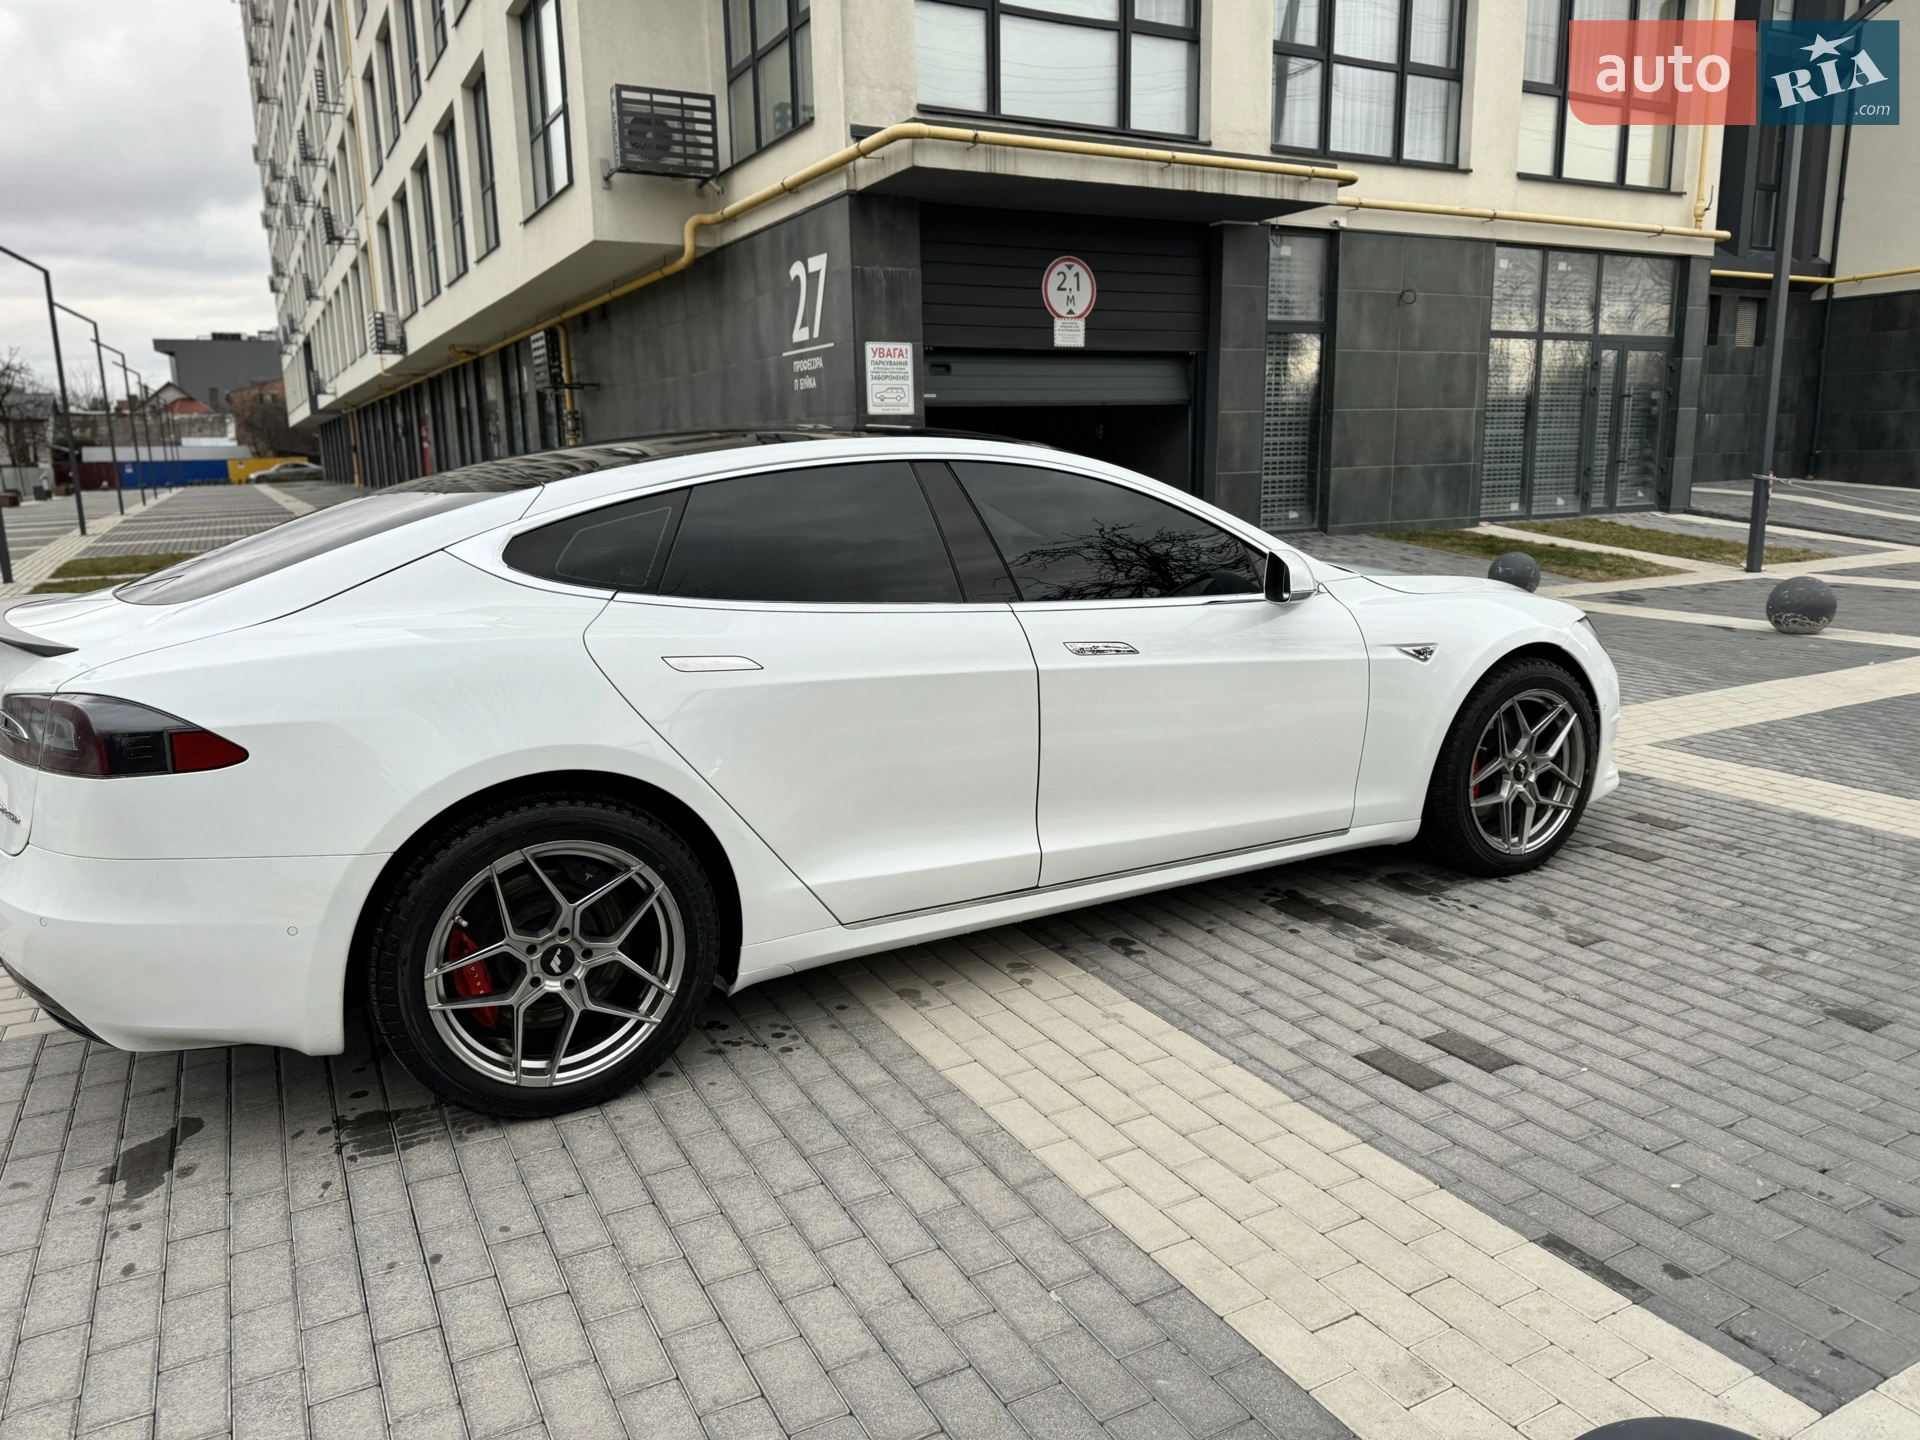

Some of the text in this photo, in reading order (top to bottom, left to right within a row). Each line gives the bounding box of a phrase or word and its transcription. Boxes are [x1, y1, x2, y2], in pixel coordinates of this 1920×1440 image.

[1056, 270, 1080, 294] 2,1
[789, 252, 828, 343] 27
[870, 347, 909, 359] УВАГА!
[793, 357, 824, 373] ПРОФЕСОРА
[799, 375, 817, 390] БУЙКА
